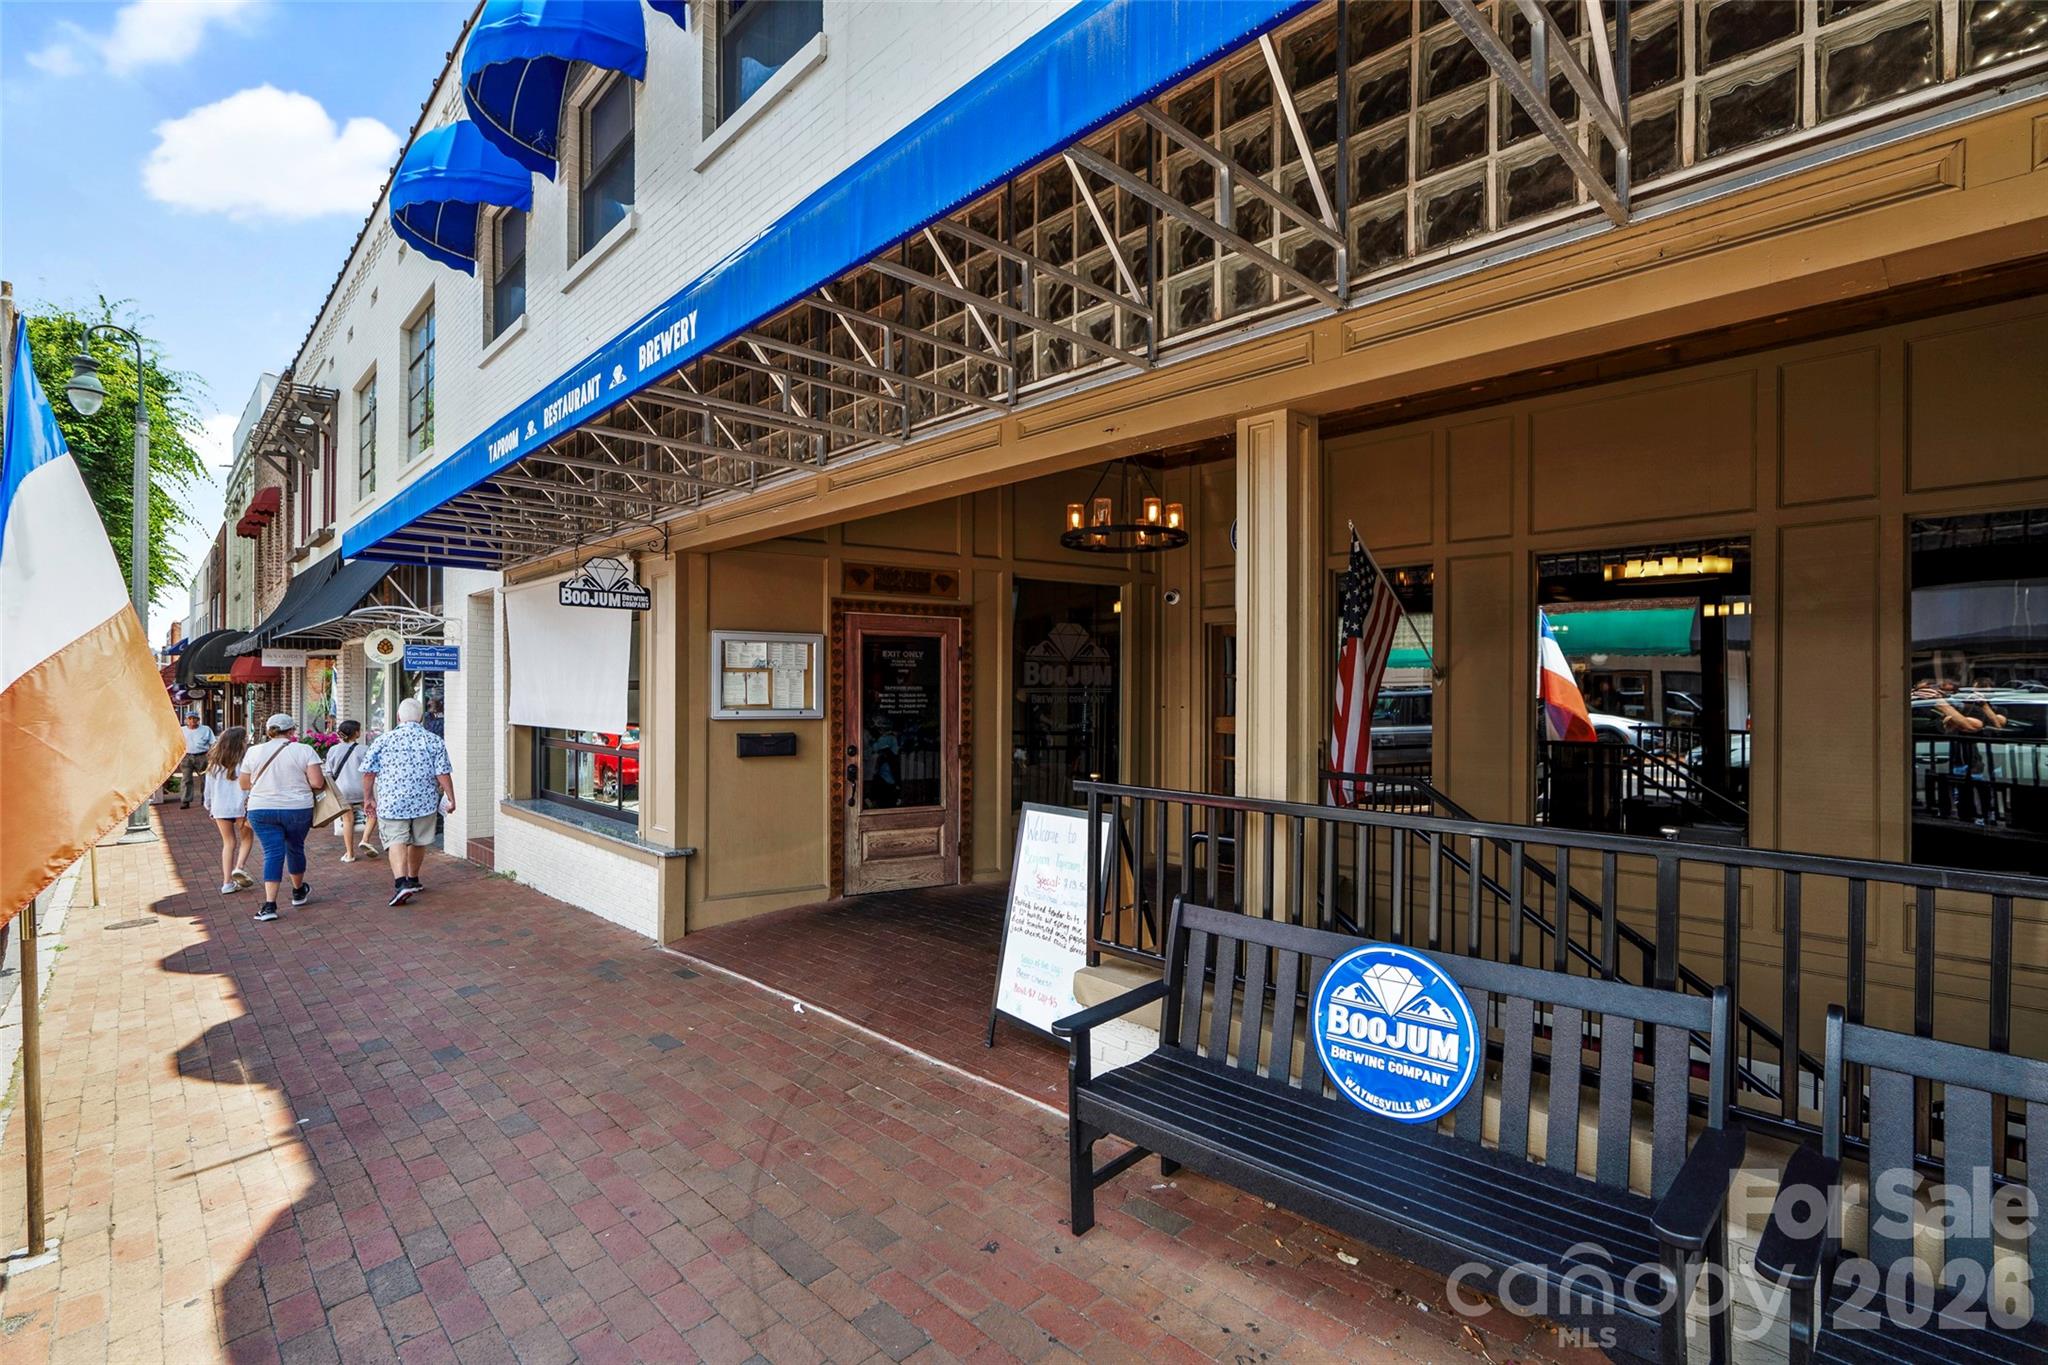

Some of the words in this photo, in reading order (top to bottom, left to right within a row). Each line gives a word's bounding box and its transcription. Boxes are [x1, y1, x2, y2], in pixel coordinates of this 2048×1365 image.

[488, 428, 519, 464] TAPROOM
[543, 373, 601, 430] RESTAURANT
[638, 310, 698, 372] BREWERY
[561, 588, 621, 607] BOOJUM
[622, 594, 649, 603] BREWING
[882, 650, 901, 658] EXIT
[1024, 662, 1112, 686] BOOJUM
[1026, 815, 1059, 844] Welcome
[1067, 822, 1078, 844] to
[1327, 1003, 1460, 1063] BOOJUM
[1331, 1045, 1385, 1071] BREWING
[1388, 1061, 1450, 1087] COMPANY
[1344, 1075, 1415, 1113] WAYNESVILLE,
[1415, 1098, 1432, 1112] NC
